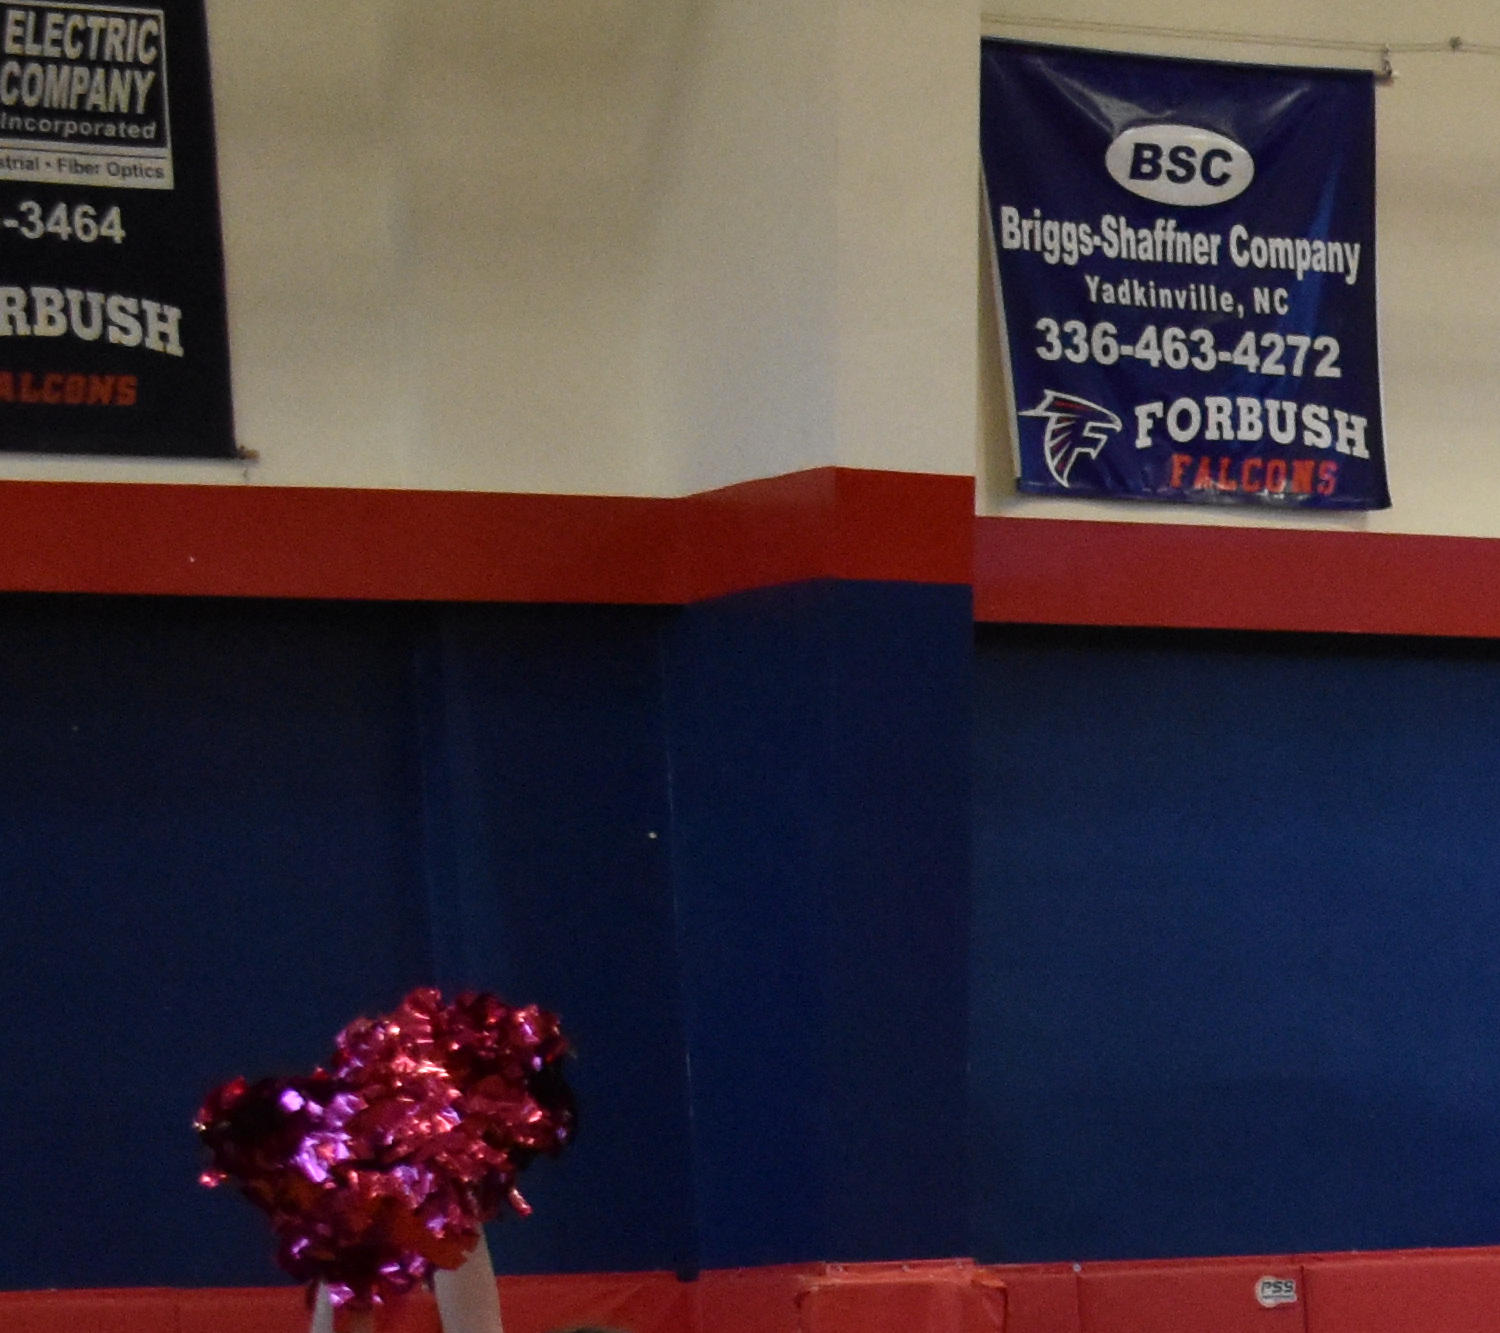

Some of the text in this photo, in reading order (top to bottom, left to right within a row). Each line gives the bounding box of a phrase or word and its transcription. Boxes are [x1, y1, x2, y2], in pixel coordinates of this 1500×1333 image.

[4, 9, 158, 64] ELECTRIC
[0, 60, 156, 115] COMPANY
[1, 112, 157, 139] Incorporated
[106, 161, 165, 179] Optics
[1129, 141, 1233, 188] BSC
[1001, 206, 1361, 285] Briggs-Shaffner Company
[1084, 274, 1289, 318] Yadkinville, NC
[1034, 317, 1342, 379] 336-463-4272
[1133, 396, 1370, 460] FORBUSH
[1170, 453, 1339, 496] FALCONS
